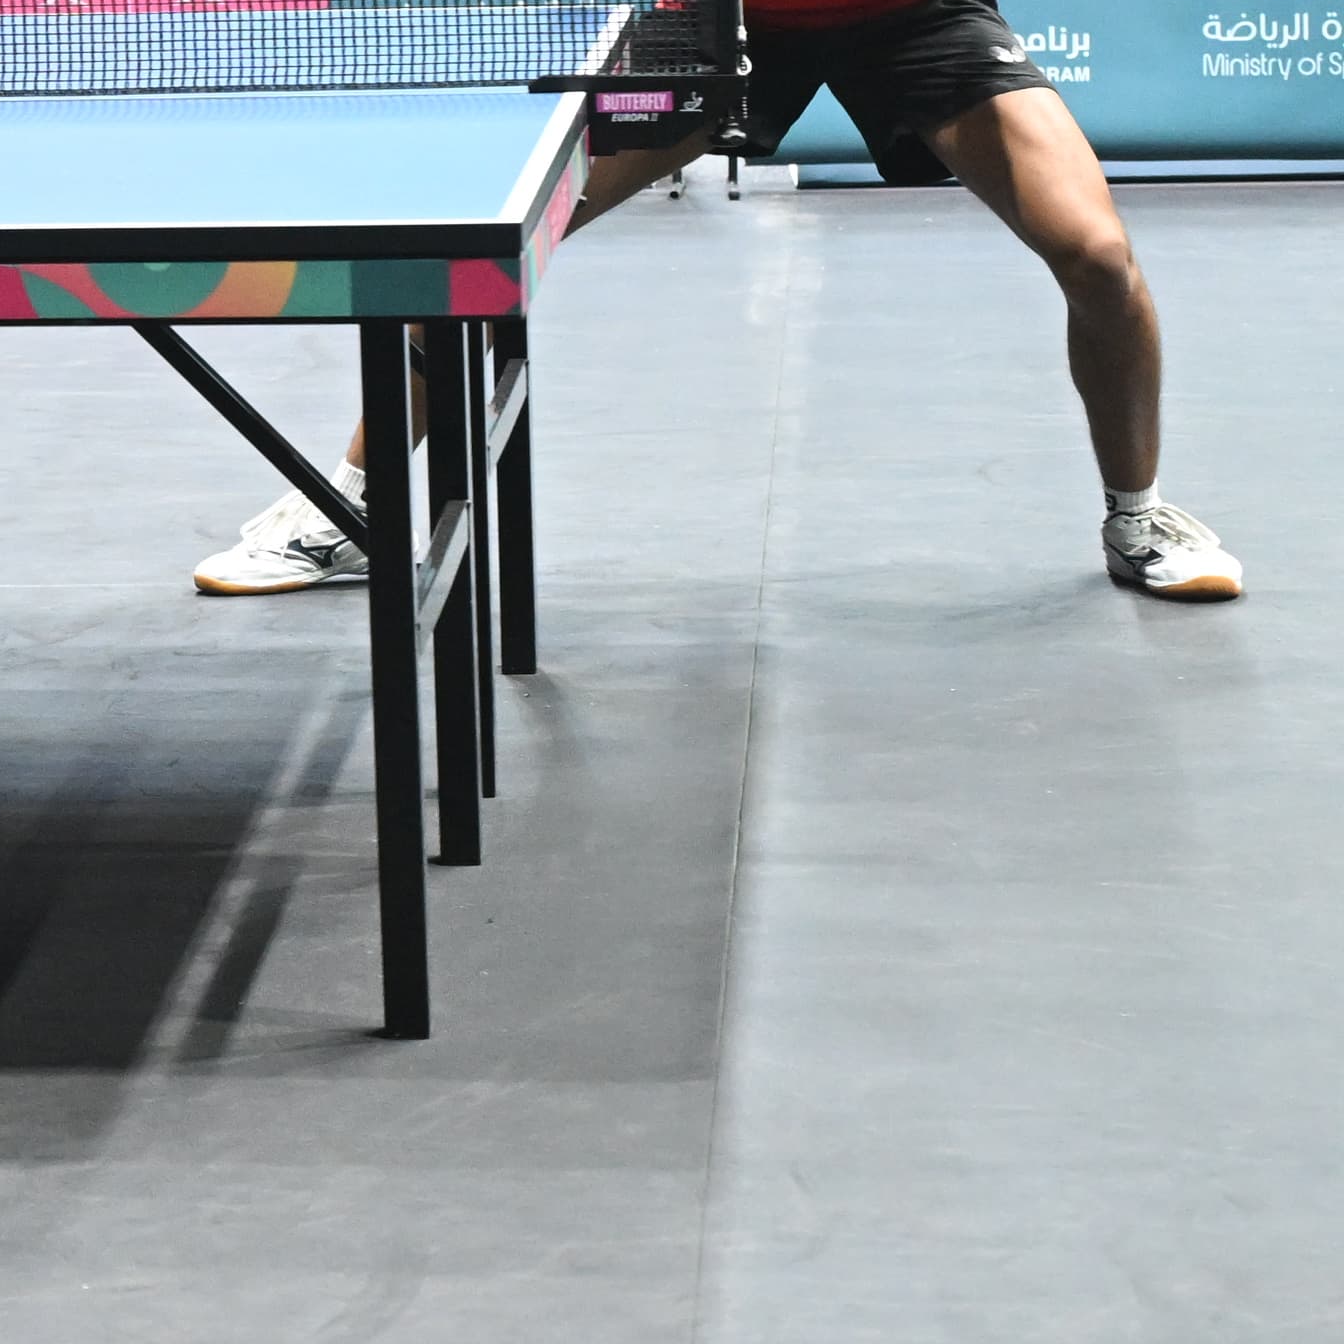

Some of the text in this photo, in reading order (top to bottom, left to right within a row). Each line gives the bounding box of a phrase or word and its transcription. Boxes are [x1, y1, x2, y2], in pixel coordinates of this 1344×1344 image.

[1202, 12, 1309, 49] الرياضة
[1202, 51, 1344, 80] Ministry of S
[1038, 66, 1090, 82] RAM
[603, 94, 667, 110] BUTTERFLY
[611, 113, 649, 122] EUROPA
